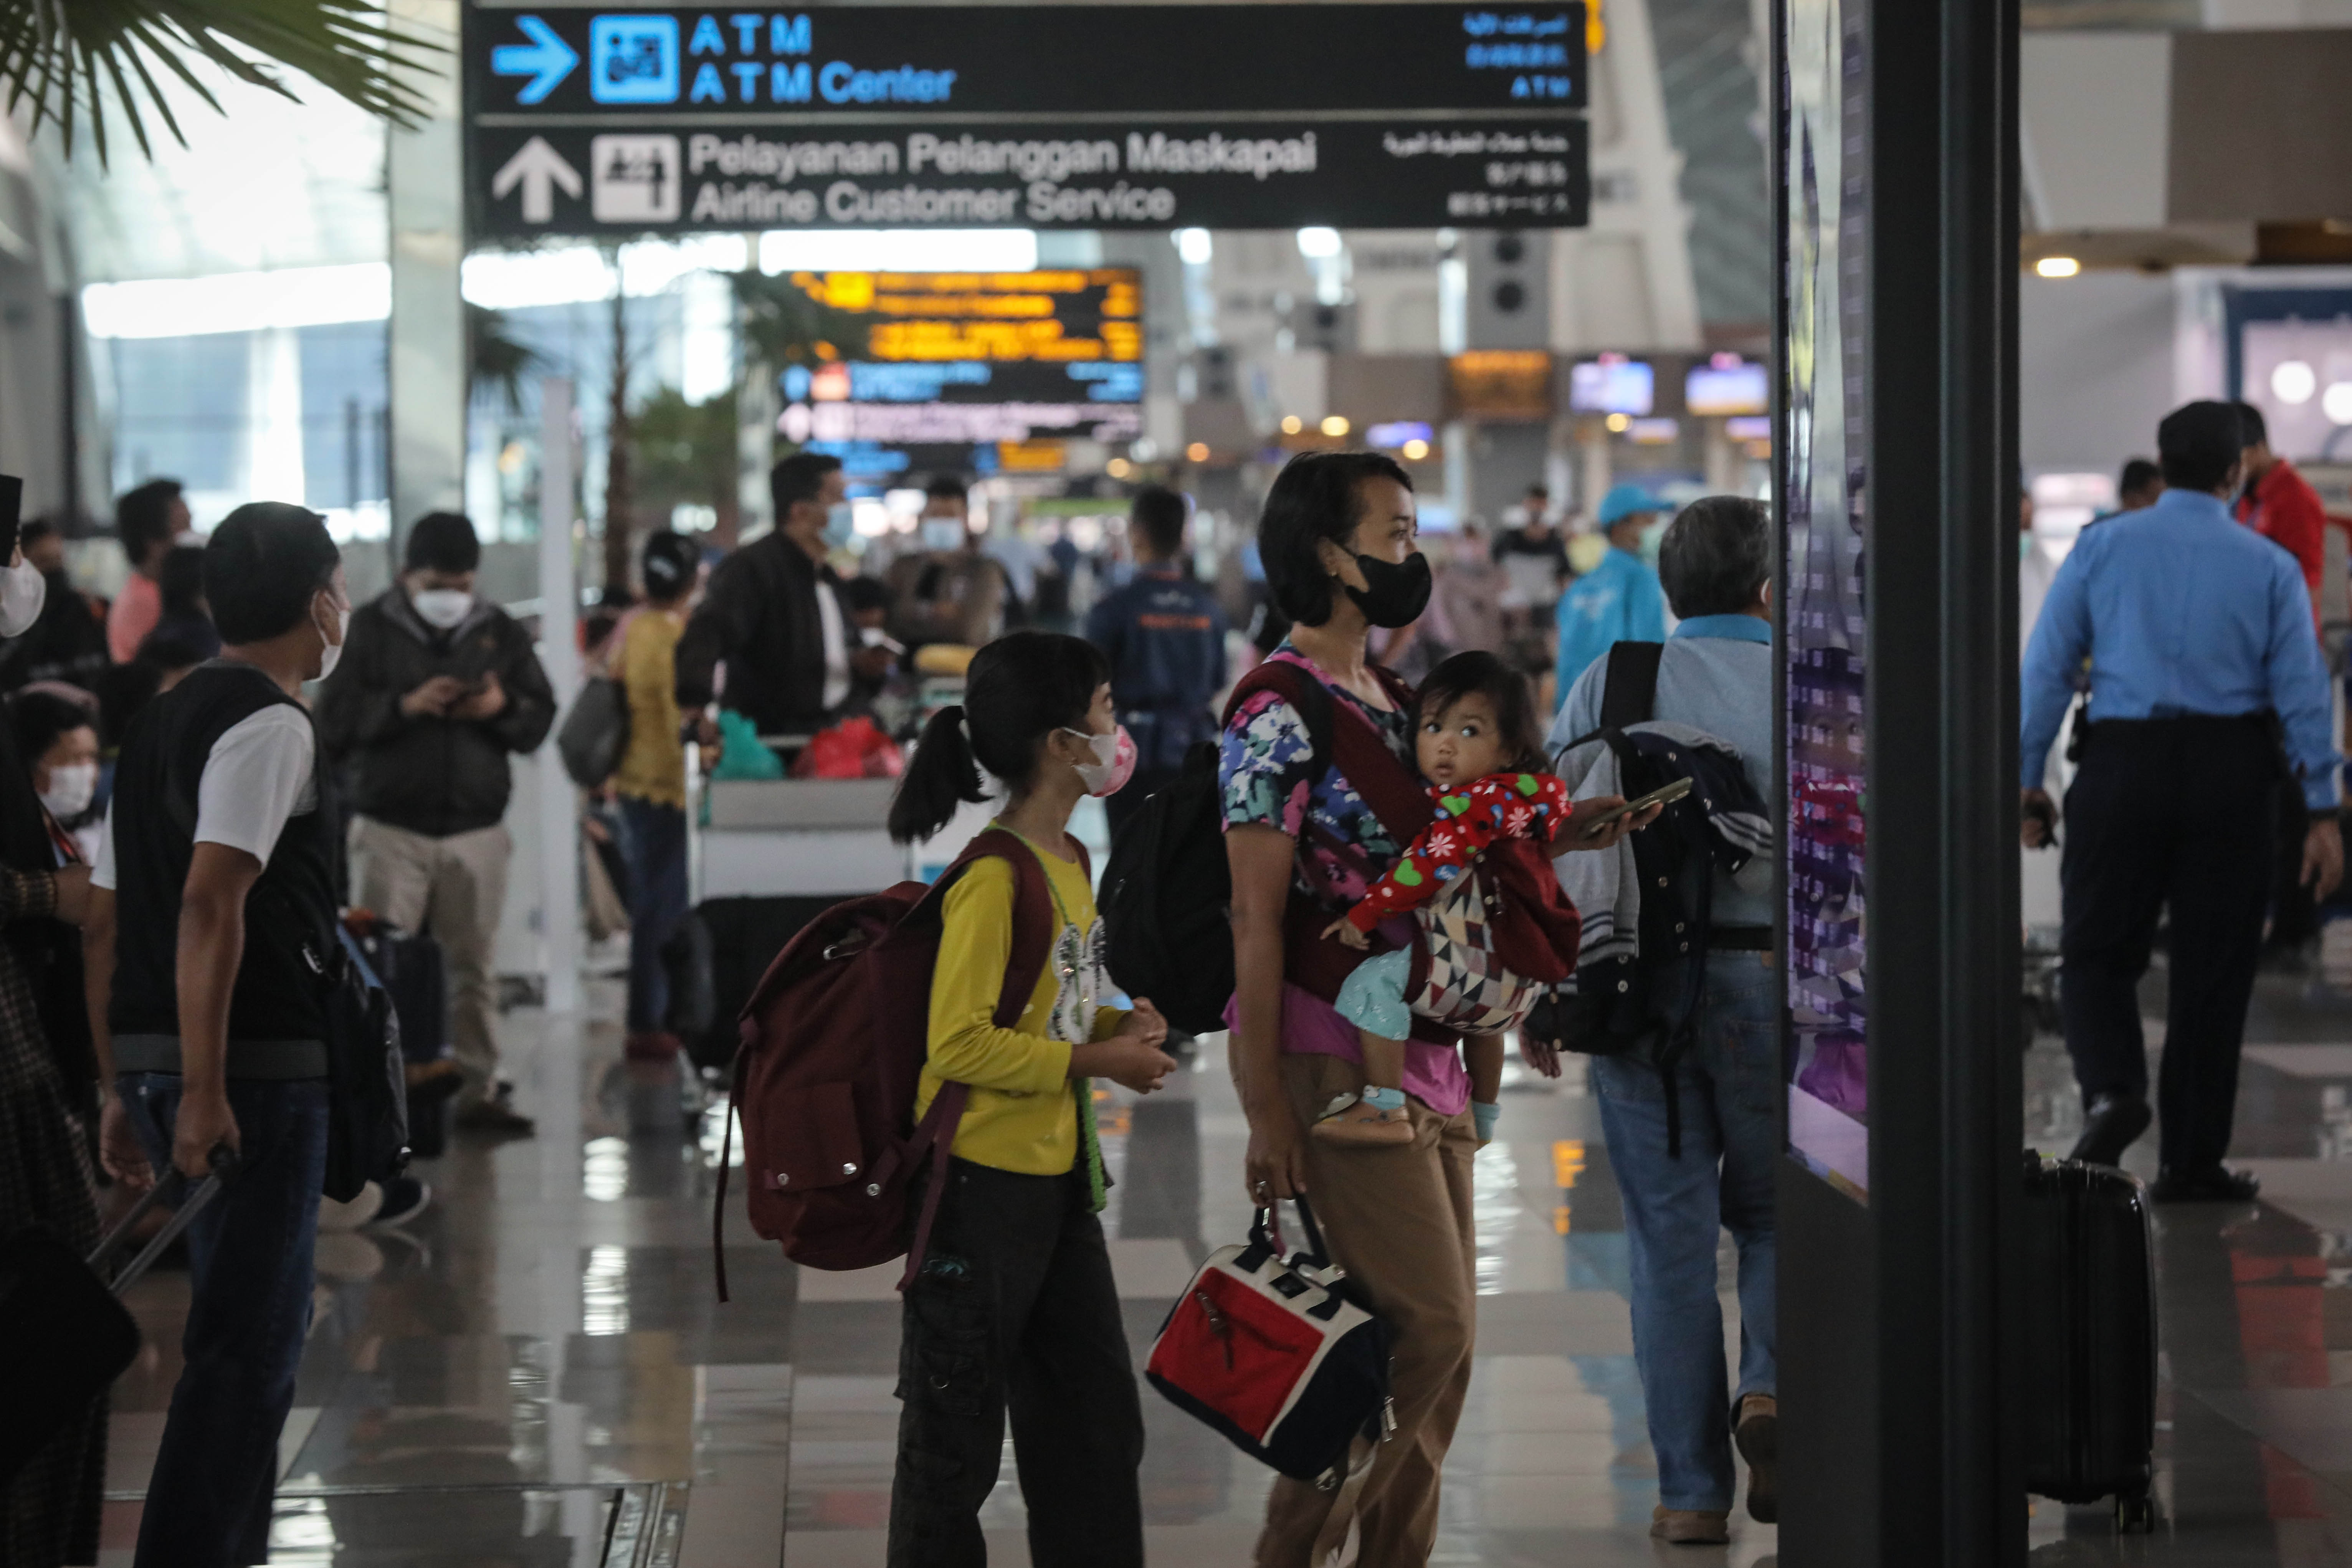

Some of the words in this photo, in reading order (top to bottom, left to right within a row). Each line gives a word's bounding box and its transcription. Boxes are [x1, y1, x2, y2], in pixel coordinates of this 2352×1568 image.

[689, 14, 812, 55] ATM
[690, 62, 812, 103] ATM
[818, 61, 957, 104] Center
[689, 134, 899, 183] Pelayanan
[907, 133, 1119, 183] Pelanggan
[1127, 131, 1317, 180] Maskapai
[691, 181, 818, 222] Airline
[825, 180, 1021, 222] Customer
[1026, 180, 1175, 221] Service
